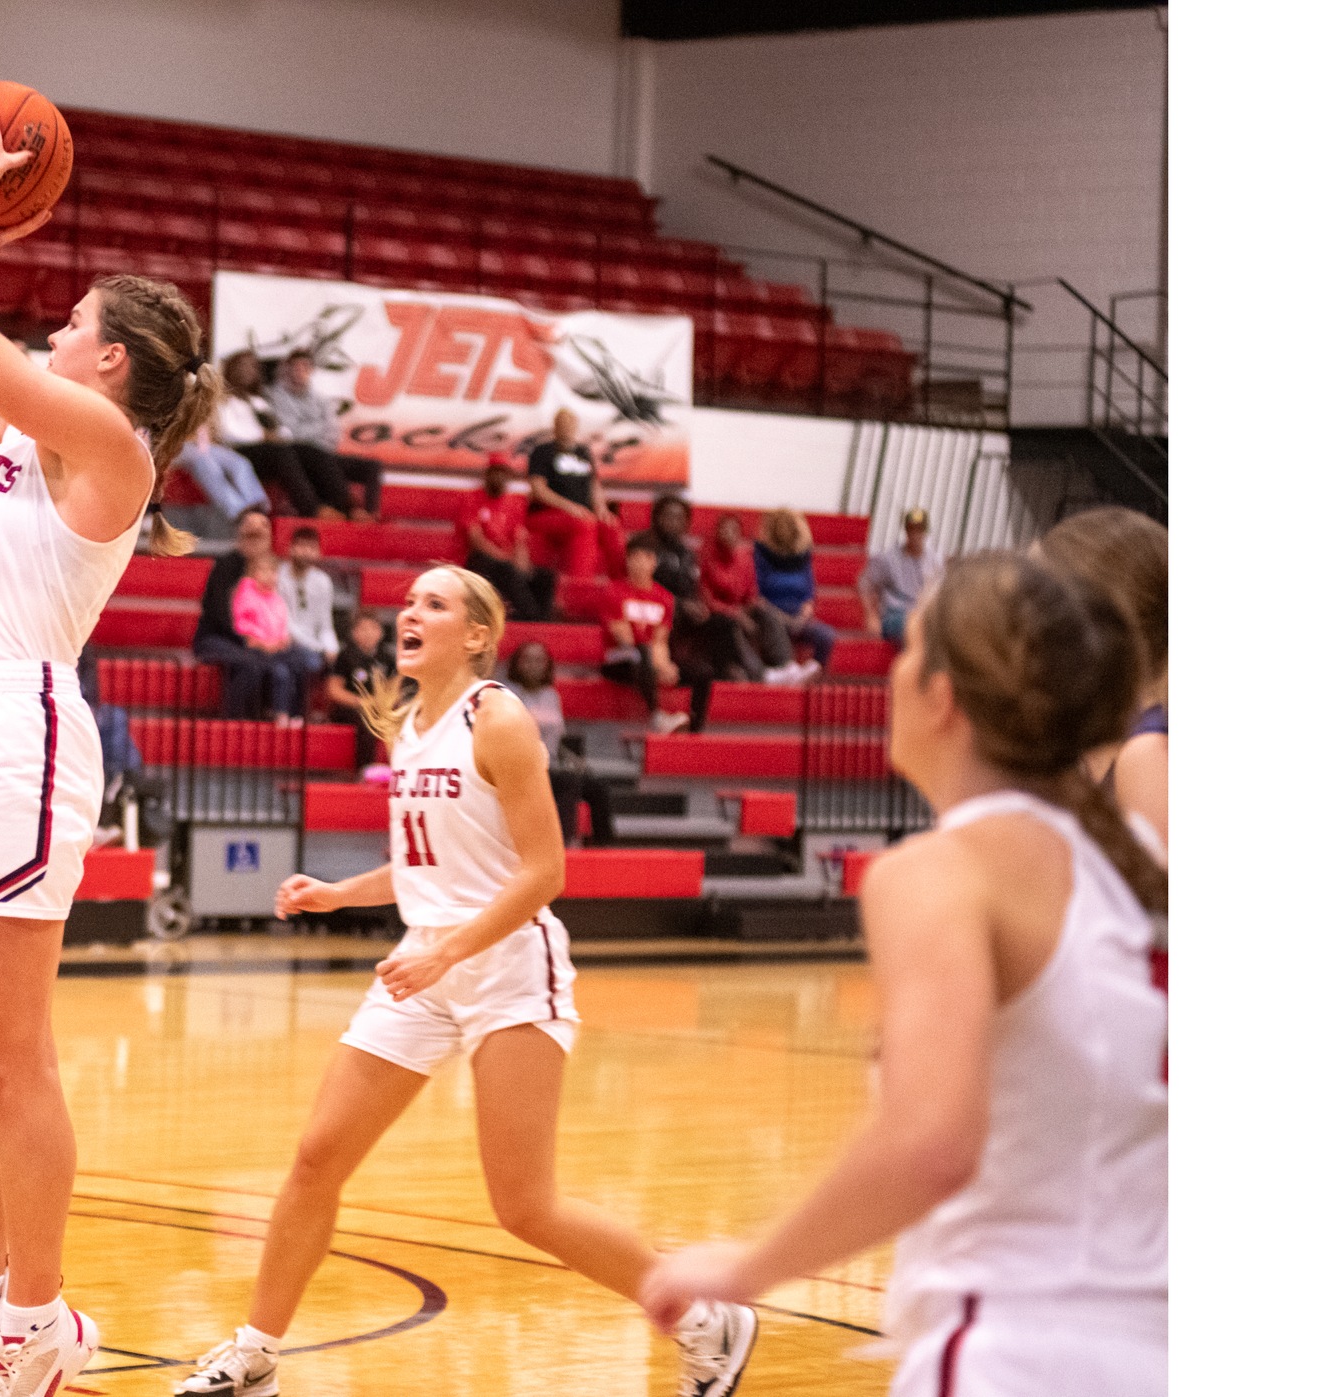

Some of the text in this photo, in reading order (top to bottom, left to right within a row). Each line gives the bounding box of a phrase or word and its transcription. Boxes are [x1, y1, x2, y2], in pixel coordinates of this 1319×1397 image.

[355, 302, 556, 406] JETS
[410, 768, 461, 798] JETS
[402, 811, 437, 866] 11
